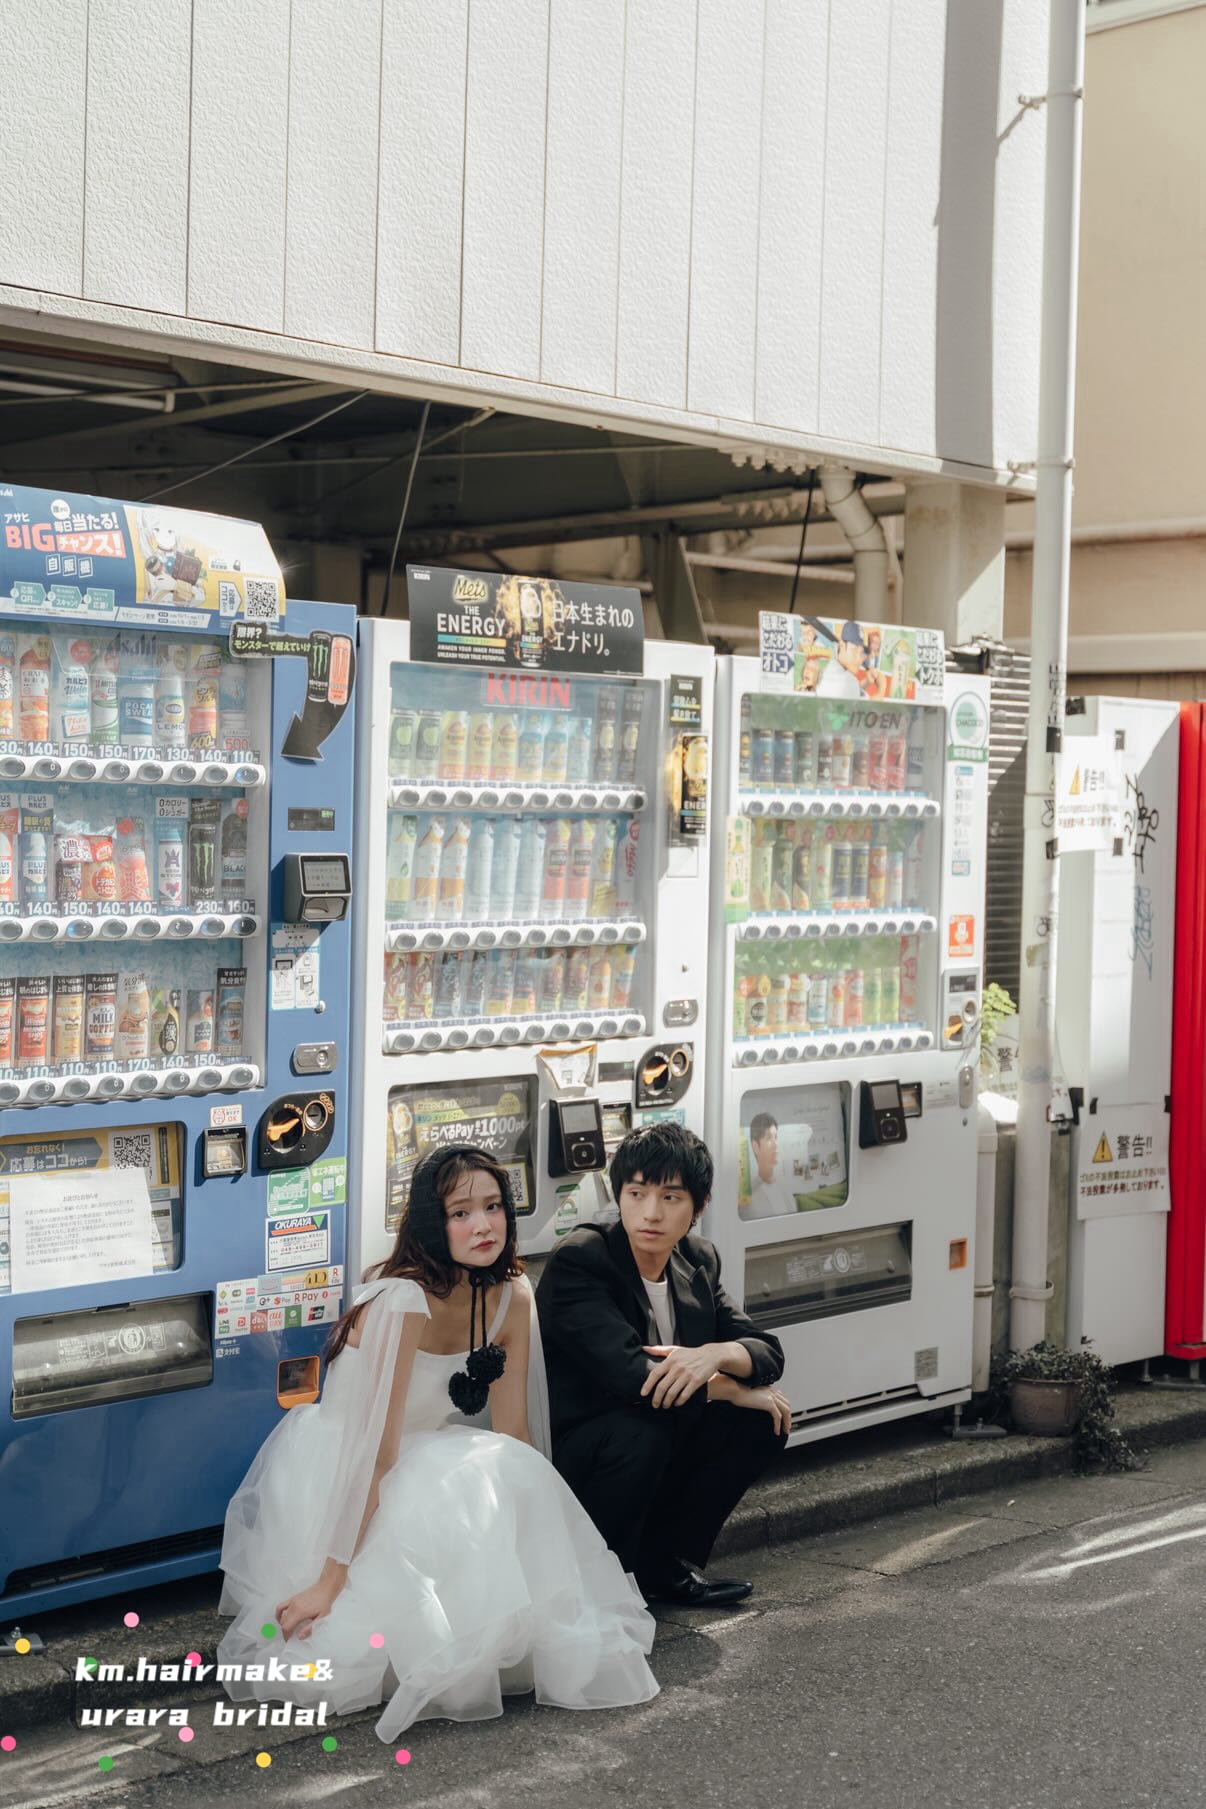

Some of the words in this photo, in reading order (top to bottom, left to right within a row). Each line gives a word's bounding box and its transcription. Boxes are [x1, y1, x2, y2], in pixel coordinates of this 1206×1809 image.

[4, 512, 30, 524] アサヒ
[54, 511, 119, 533] 毎日当たる!
[5, 523, 55, 552] BIG
[59, 533, 123, 555] チャンス!
[455, 579, 487, 601] Mets
[464, 605, 480, 615] THE
[551, 601, 634, 628] 日本生まれの
[437, 613, 506, 636] ENERGY
[234, 640, 312, 653] モンスターで超えていけ
[552, 630, 610, 656] エナドリ。
[763, 654, 789, 673] オトコ
[487, 672, 570, 708] KIRIN
[849, 711, 878, 729] ITO
[879, 713, 901, 730] EN
[9, 1153, 87, 1173] 応募はココから!
[274, 1216, 312, 1231] OKURAYA
